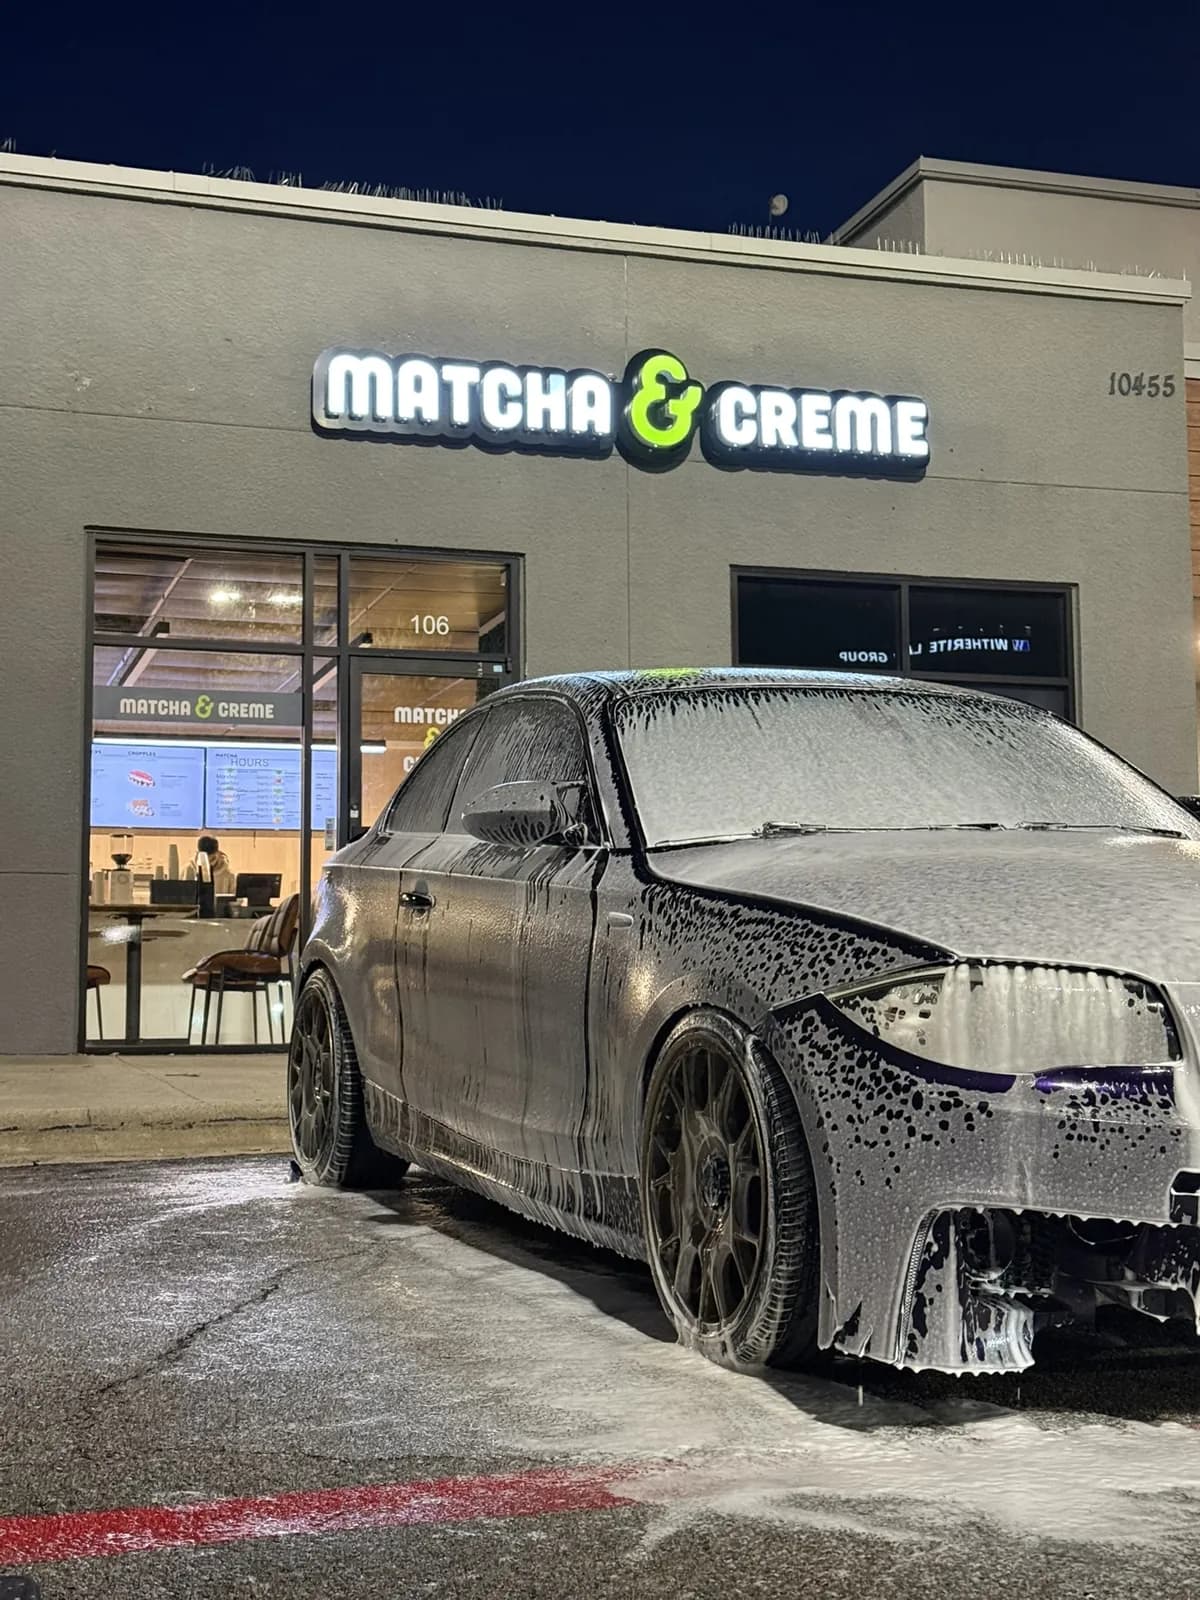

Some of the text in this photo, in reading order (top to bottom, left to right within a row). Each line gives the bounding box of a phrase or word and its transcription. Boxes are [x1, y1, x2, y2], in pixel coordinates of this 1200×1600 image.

[1108, 372, 1176, 398] 10455
[327, 352, 931, 457] MATCHA & CREME
[410, 614, 450, 636] 106
[119, 694, 274, 719] MATCHA & CREME
[231, 758, 270, 767] HOURS
